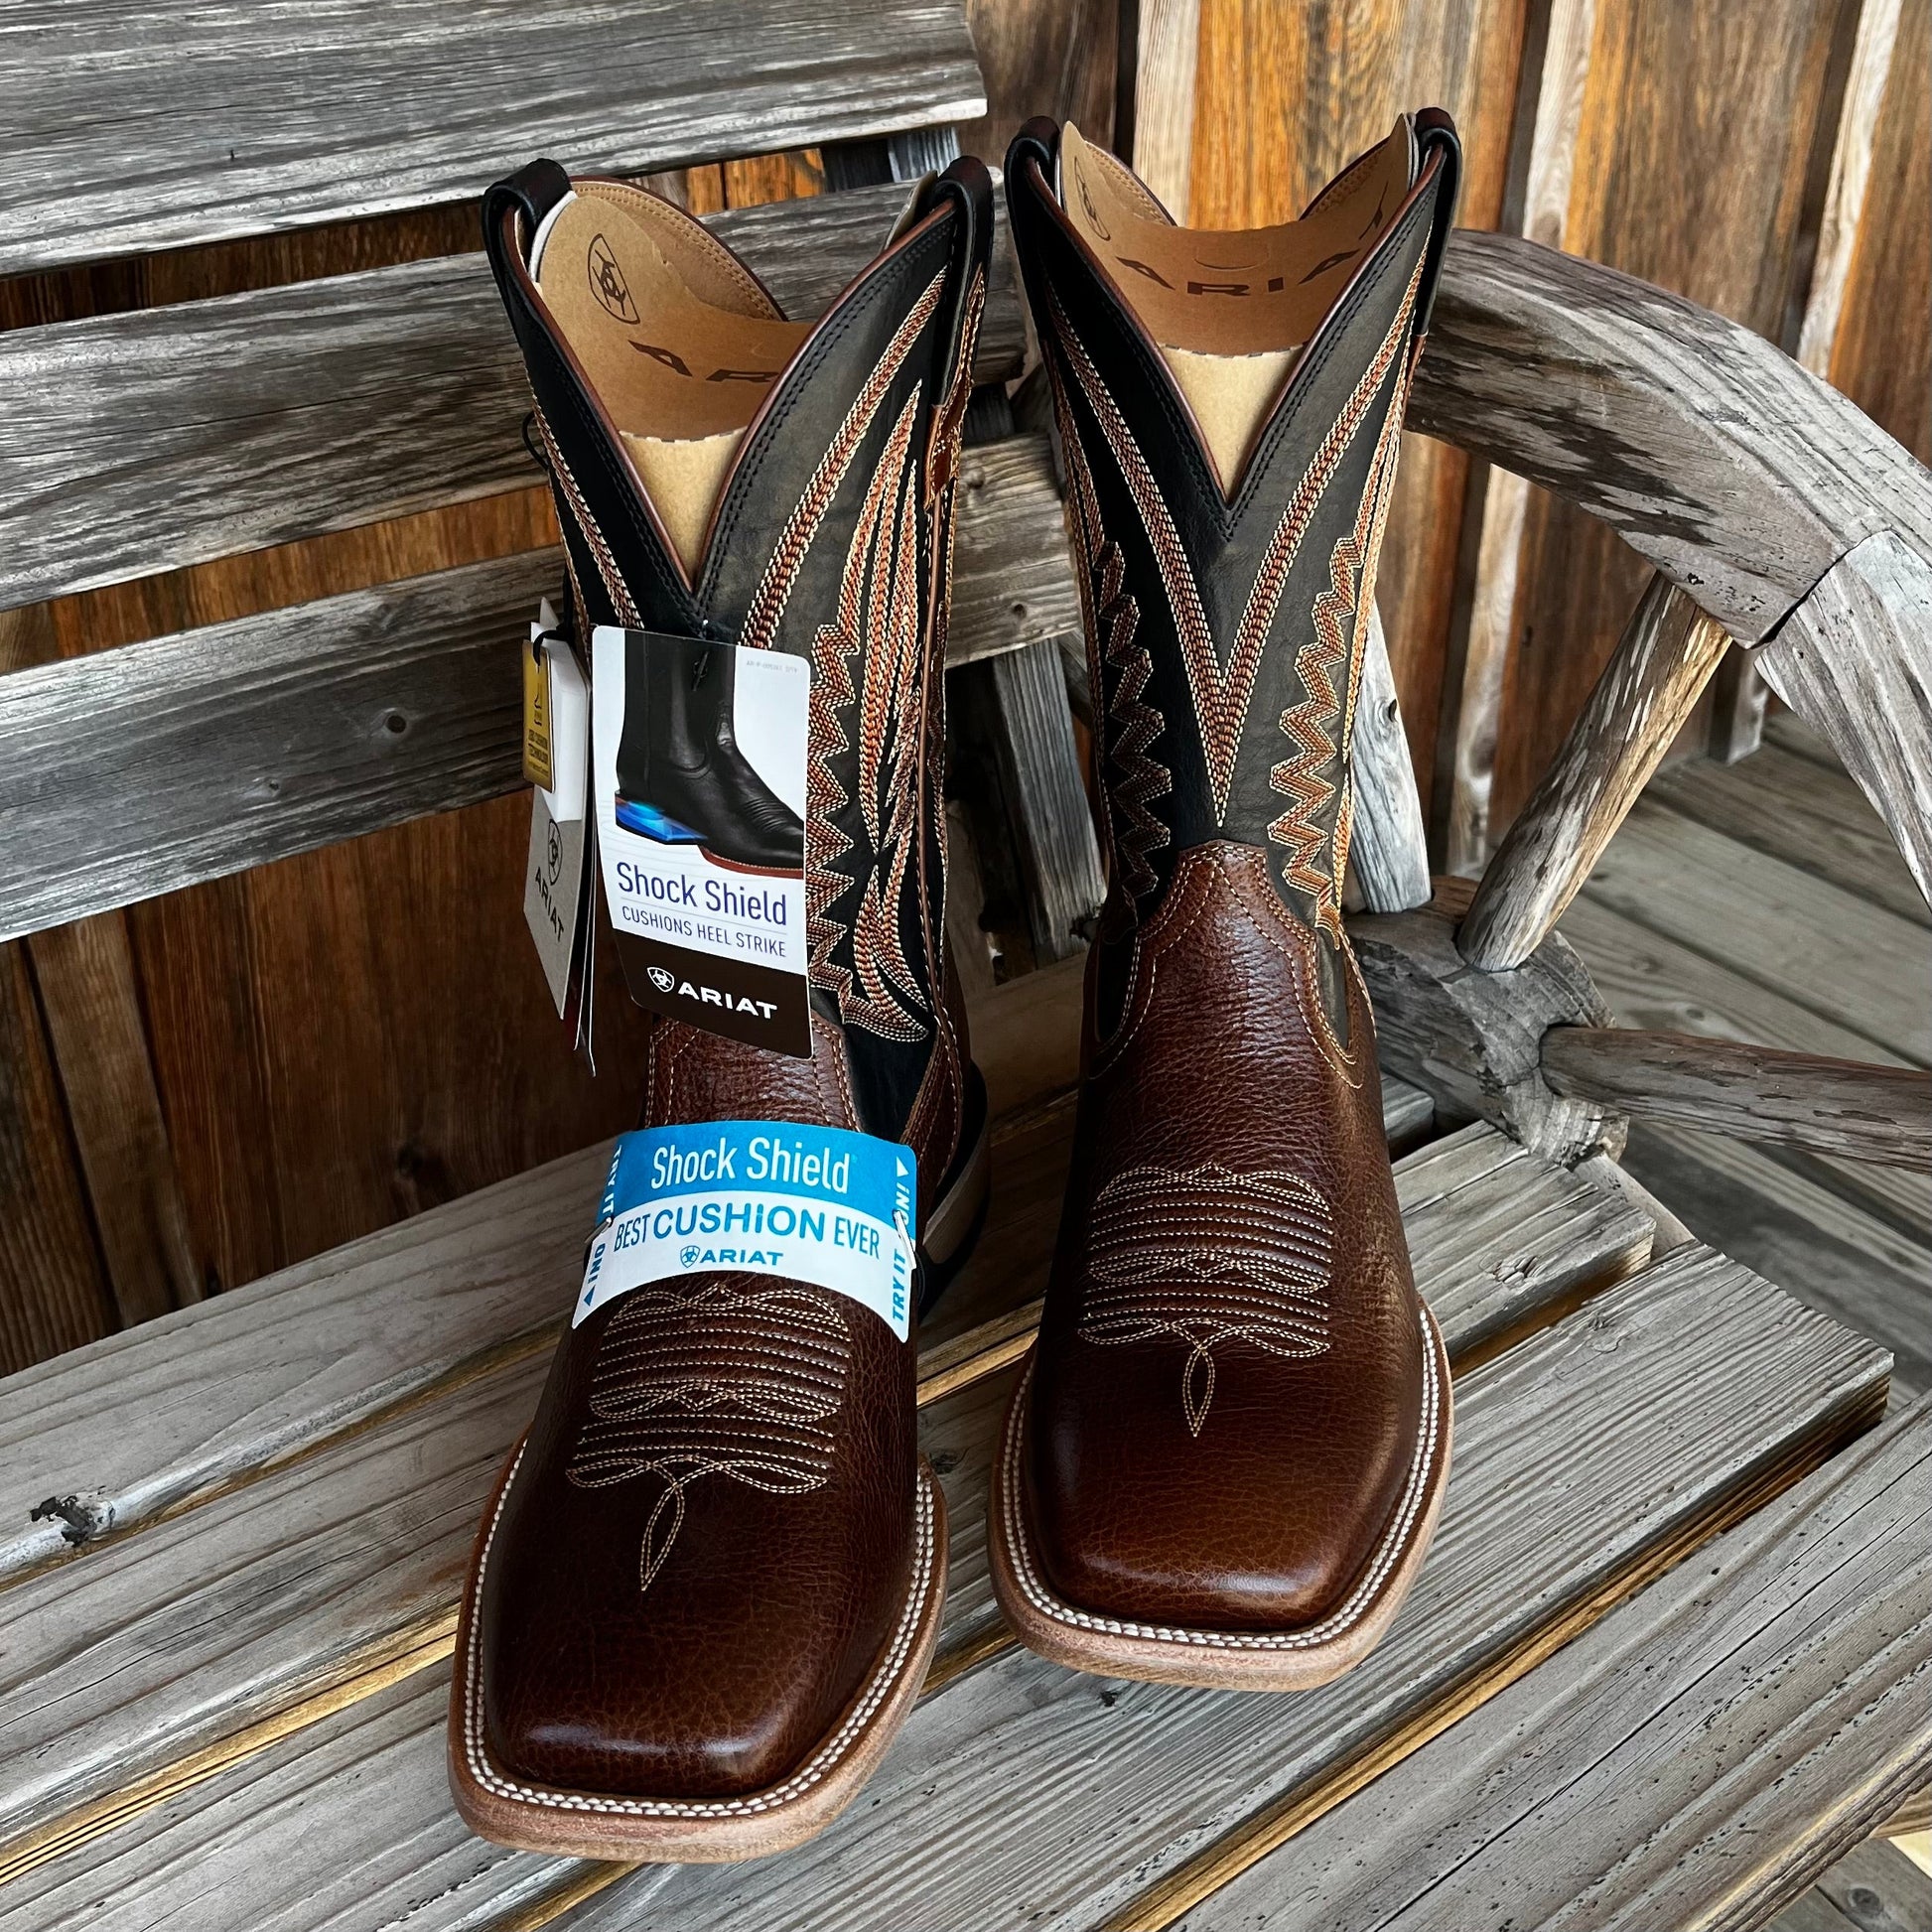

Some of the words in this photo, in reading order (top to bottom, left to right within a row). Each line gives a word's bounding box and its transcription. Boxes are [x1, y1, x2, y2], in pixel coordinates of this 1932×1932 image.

[535, 866, 565, 942] ARIAT
[617, 862, 698, 907] Shock
[705, 880, 787, 926] Shield
[621, 905, 693, 936] CUSHIONS
[697, 923, 732, 945] HEEL
[736, 931, 786, 957] STRIKE
[678, 981, 777, 1020] ARIAT
[608, 1145, 622, 1186] TRY
[651, 1137, 738, 1189] Shock
[747, 1137, 850, 1194] Shield
[602, 1192, 615, 1214] IT
[614, 1213, 650, 1253] BEST
[653, 1202, 823, 1242] CUSHION
[834, 1220, 880, 1260] EVER
[699, 1249, 783, 1267] ARIAT
[894, 1248, 905, 1275] IT
[893, 1276, 905, 1321] TRY
